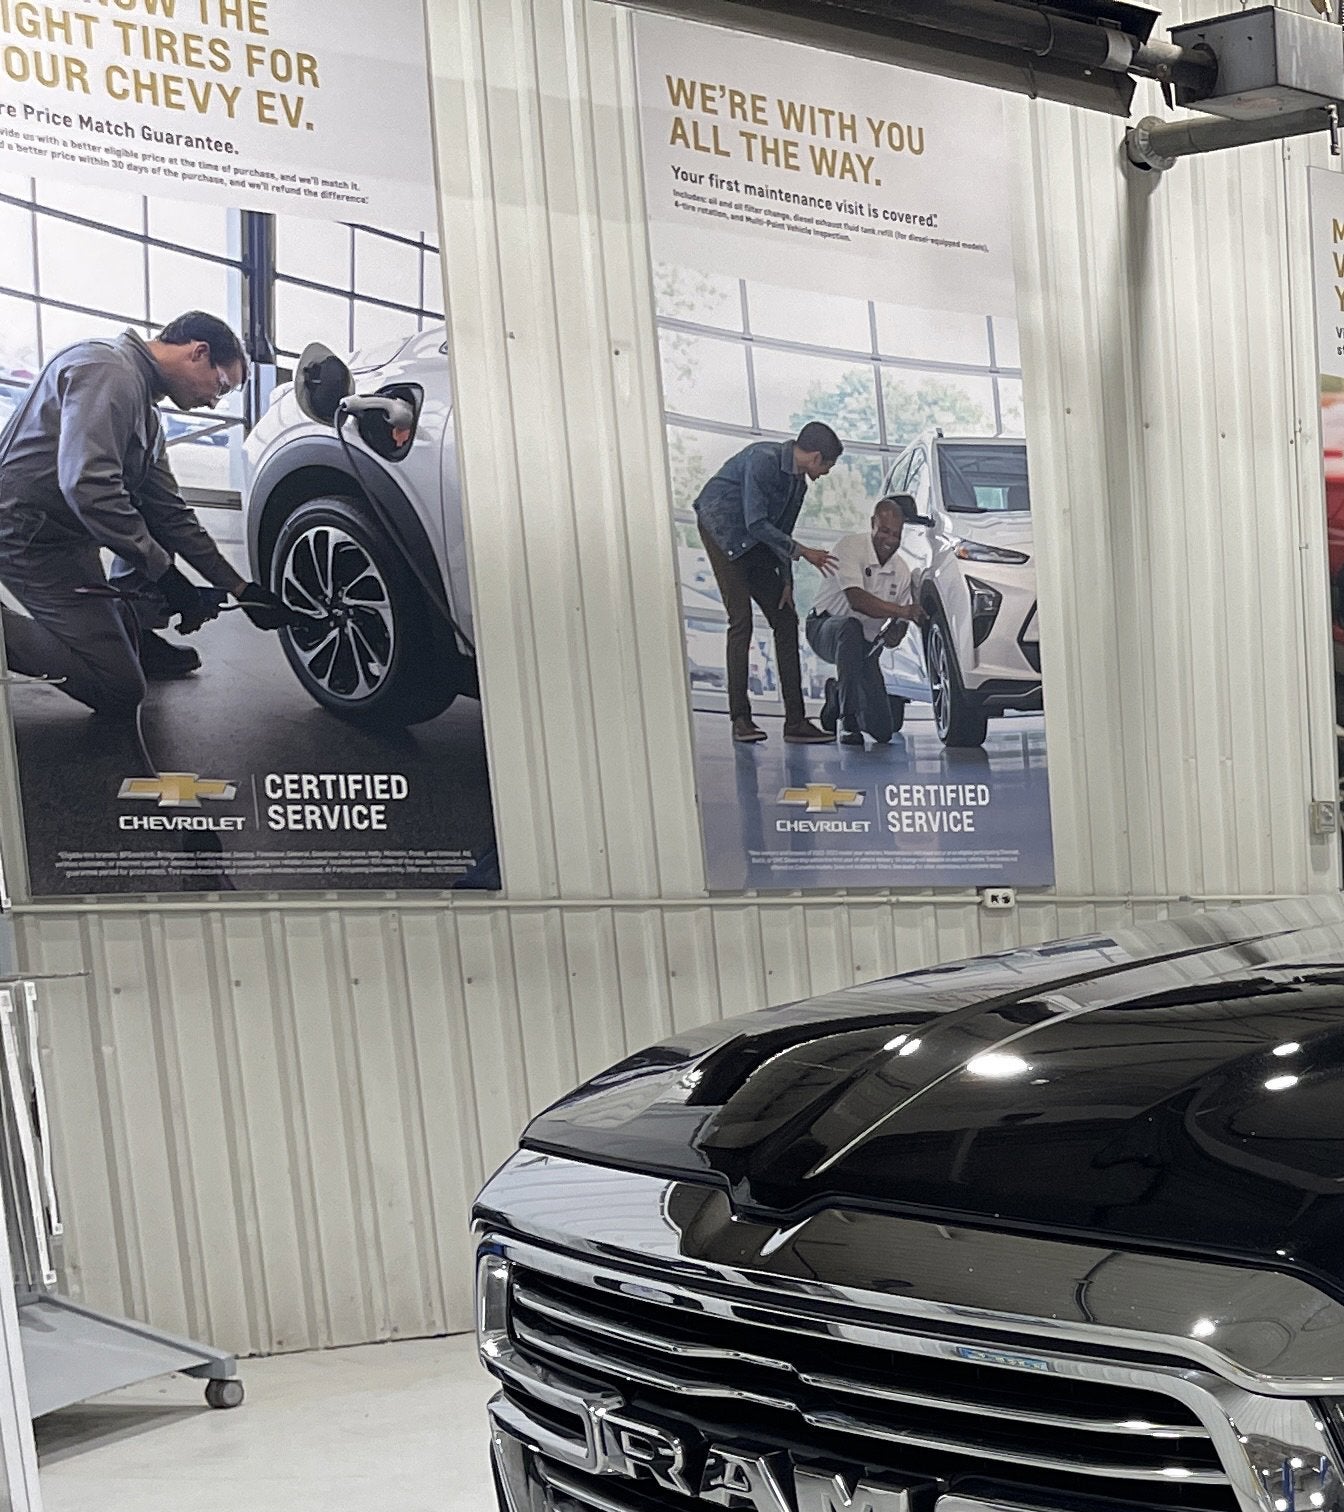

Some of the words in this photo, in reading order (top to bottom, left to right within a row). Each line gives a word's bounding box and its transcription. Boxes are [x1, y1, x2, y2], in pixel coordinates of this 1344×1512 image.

[1, 1, 99, 49] IGHT
[113, 20, 231, 72] TIRES
[246, 44, 320, 88] FOR
[4, 46, 90, 94] OUR
[105, 65, 241, 119] CHEVY
[256, 90, 314, 131] EV.
[23, 103, 72, 127] Price
[79, 114, 135, 138] Match
[142, 125, 239, 154] Guarantee.
[665, 74, 768, 126] WE'RE
[777, 99, 857, 144] WITH
[866, 116, 924, 156] YOU
[669, 116, 731, 158] ALL
[739, 130, 800, 171] THE
[809, 144, 882, 187] WAY.
[671, 165, 704, 185] Your
[708, 173, 740, 193] first
[744, 183, 832, 211] maintenance
[835, 199, 864, 216] visit
[867, 203, 879, 219] is
[264, 774, 408, 800] CERTIFIED
[884, 784, 990, 807] CERTIFIED
[119, 815, 246, 831] CHEVROLET
[268, 804, 387, 831] SERVICE
[775, 819, 871, 833] CHEVROLET
[887, 811, 975, 833] SERVICE
